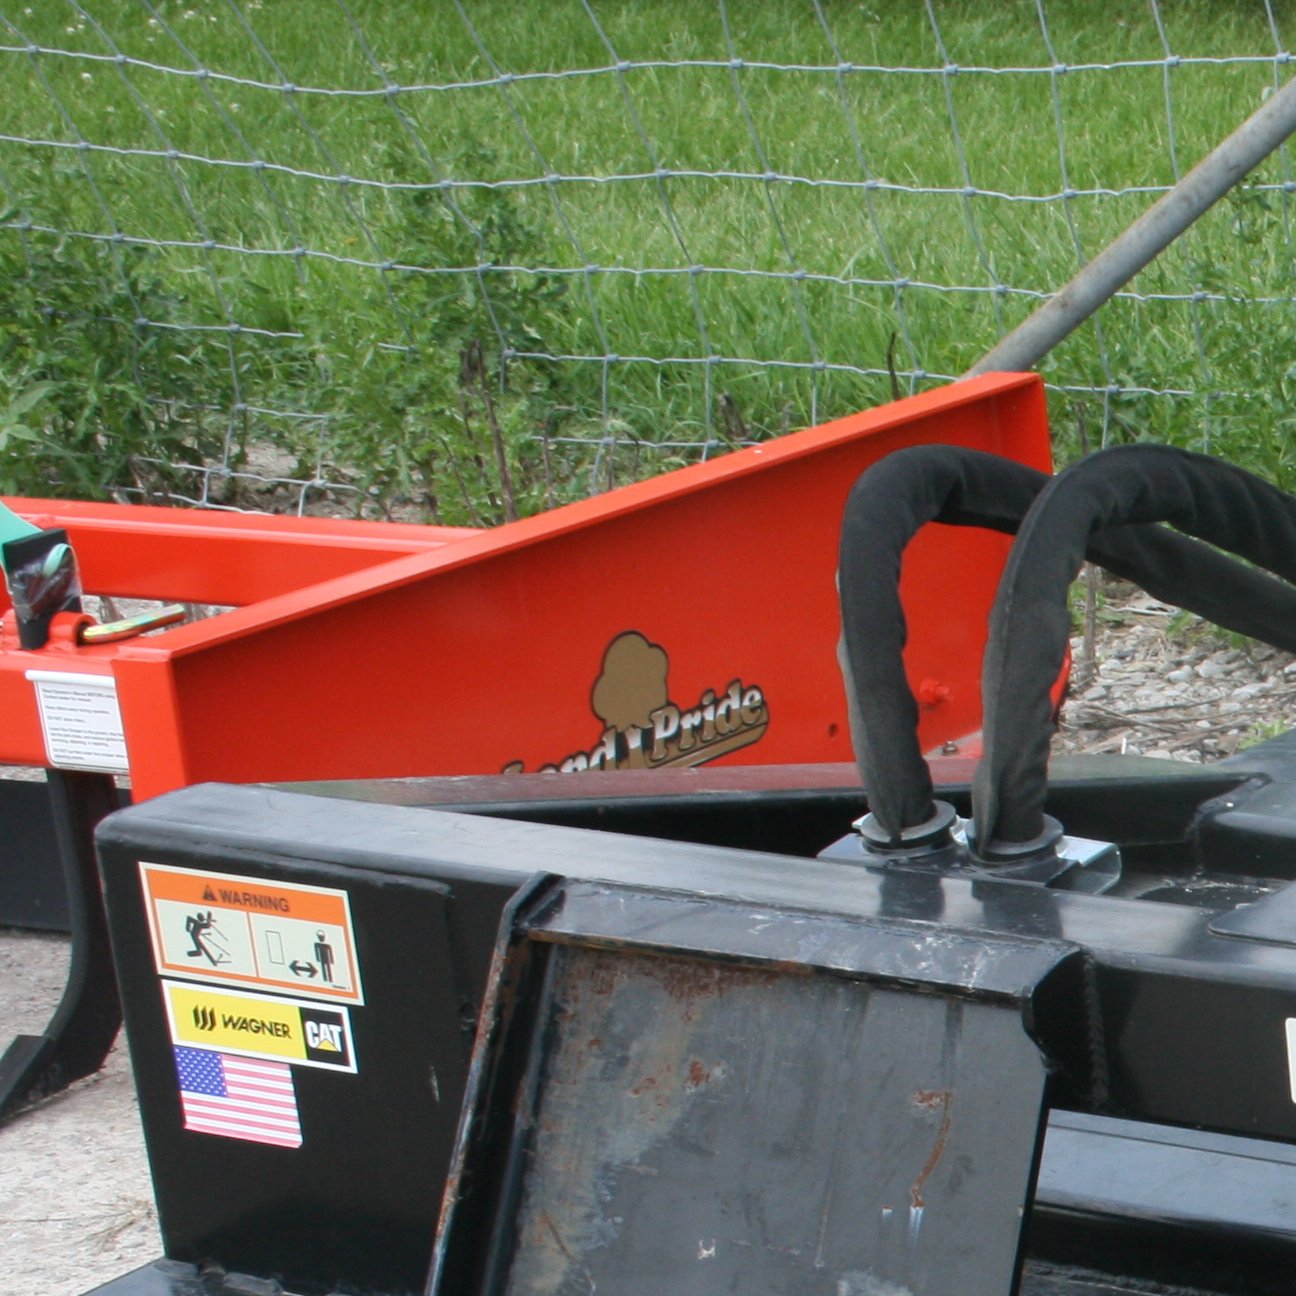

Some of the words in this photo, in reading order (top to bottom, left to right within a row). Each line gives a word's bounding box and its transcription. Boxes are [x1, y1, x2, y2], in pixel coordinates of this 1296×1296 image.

[648, 679, 765, 761] Pride
[218, 888, 291, 913] WARNING
[221, 1013, 292, 1040] WAGNER
[305, 1021, 343, 1052] CAT
